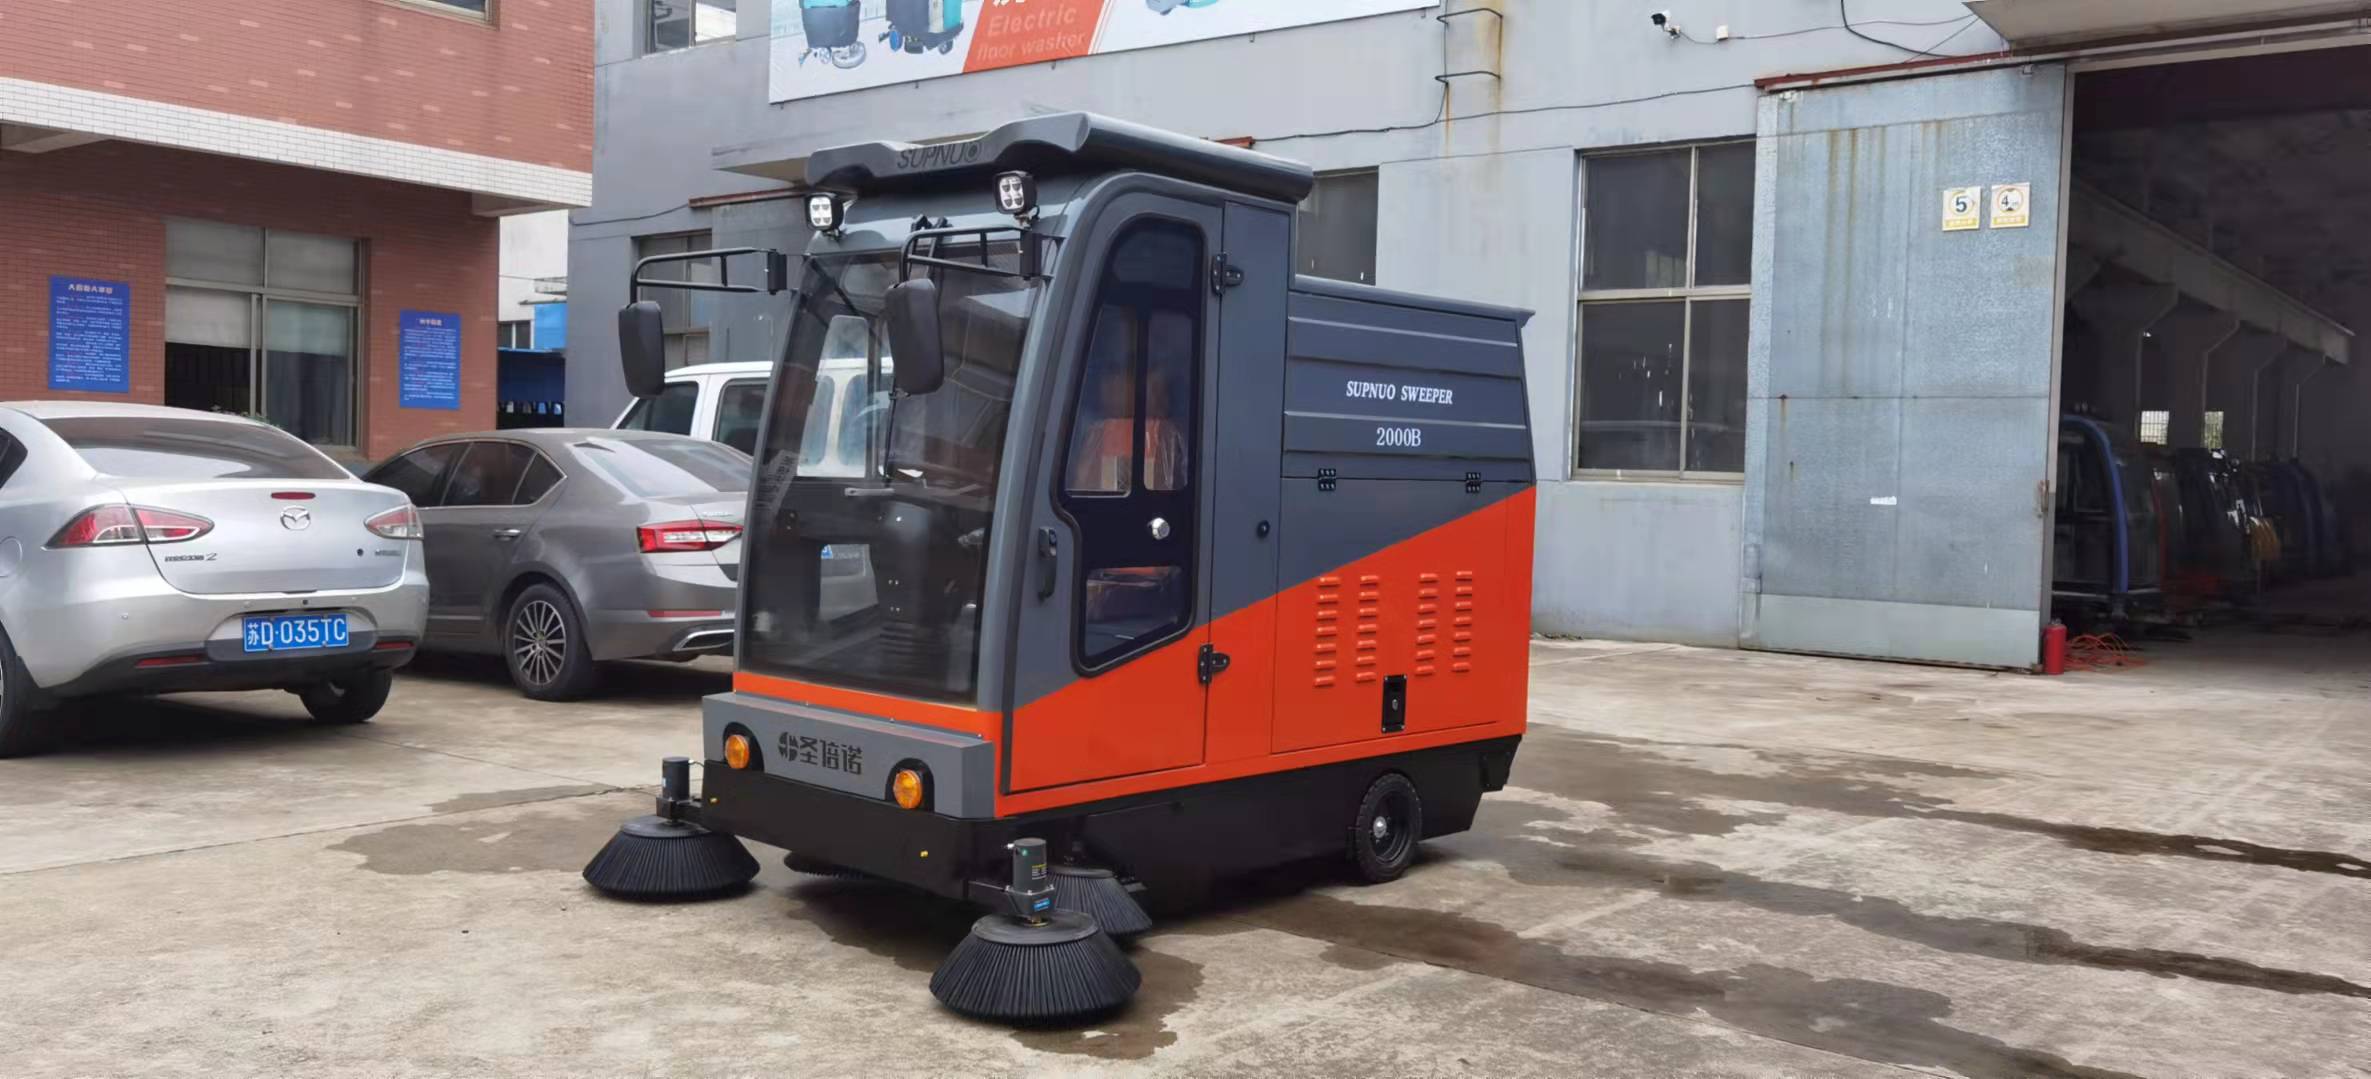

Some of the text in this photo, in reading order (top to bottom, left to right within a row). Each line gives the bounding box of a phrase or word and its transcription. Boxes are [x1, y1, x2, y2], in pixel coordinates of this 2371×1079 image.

[988, 4, 1077, 36] Electric
[1020, 32, 1086, 55] washer
[897, 142, 984, 169] SUPNUO
[1956, 196, 1967, 212] 5
[1346, 380, 1453, 405] SUPNUO SWEEPER
[1376, 427, 1421, 447] 2000B
[799, 735, 862, 775] 圣倍诺
